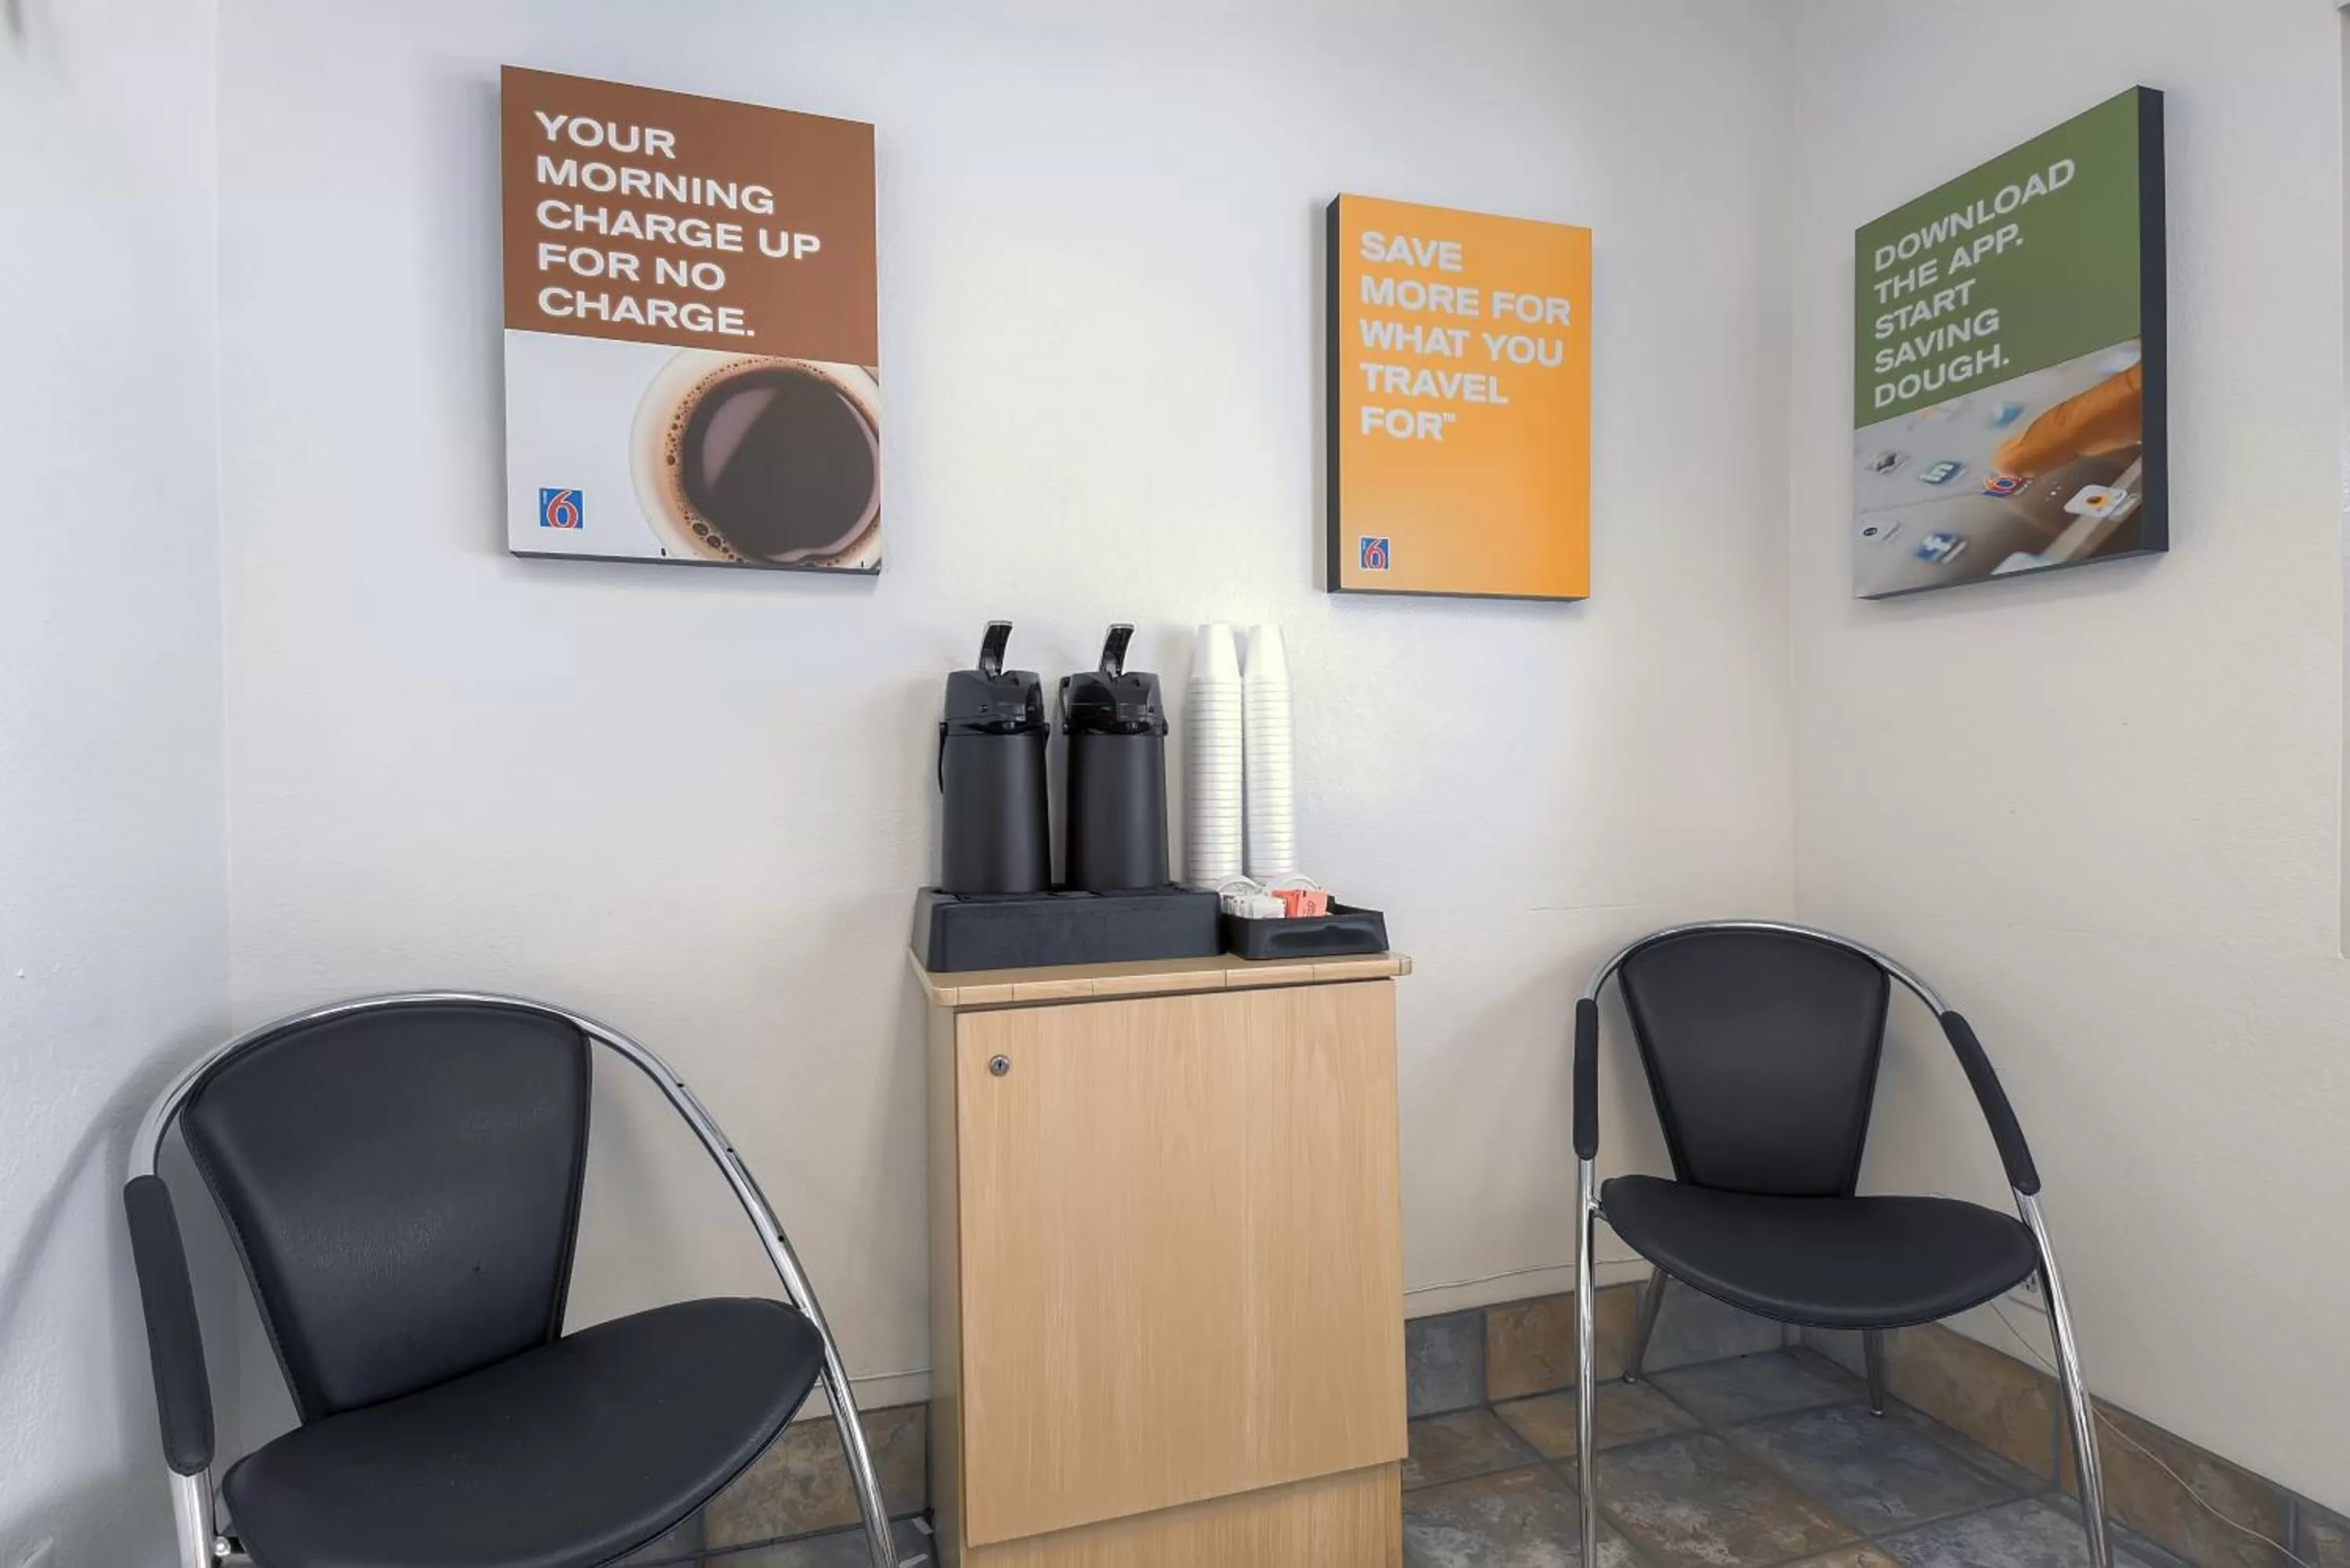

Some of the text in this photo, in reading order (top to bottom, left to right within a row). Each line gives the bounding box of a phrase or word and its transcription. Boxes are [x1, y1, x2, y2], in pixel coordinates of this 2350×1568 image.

[534, 110, 676, 159] YOUR
[537, 155, 774, 215] MORNING
[537, 200, 821, 260] CHARGE UP
[1875, 159, 2076, 272] DOWNLOAD
[538, 242, 726, 291] FOR NO
[1360, 231, 1462, 273] SAVE
[1875, 223, 2024, 303] THE APP.
[538, 287, 755, 337] CHARGE.
[1360, 275, 1571, 326] MORE FOR
[1875, 278, 1976, 339] START
[1359, 319, 1564, 367] WHAT YOU
[1875, 309, 2000, 373] SAVING
[1359, 361, 1509, 404] TRAVEL
[1875, 344, 2010, 408] DOUGH.
